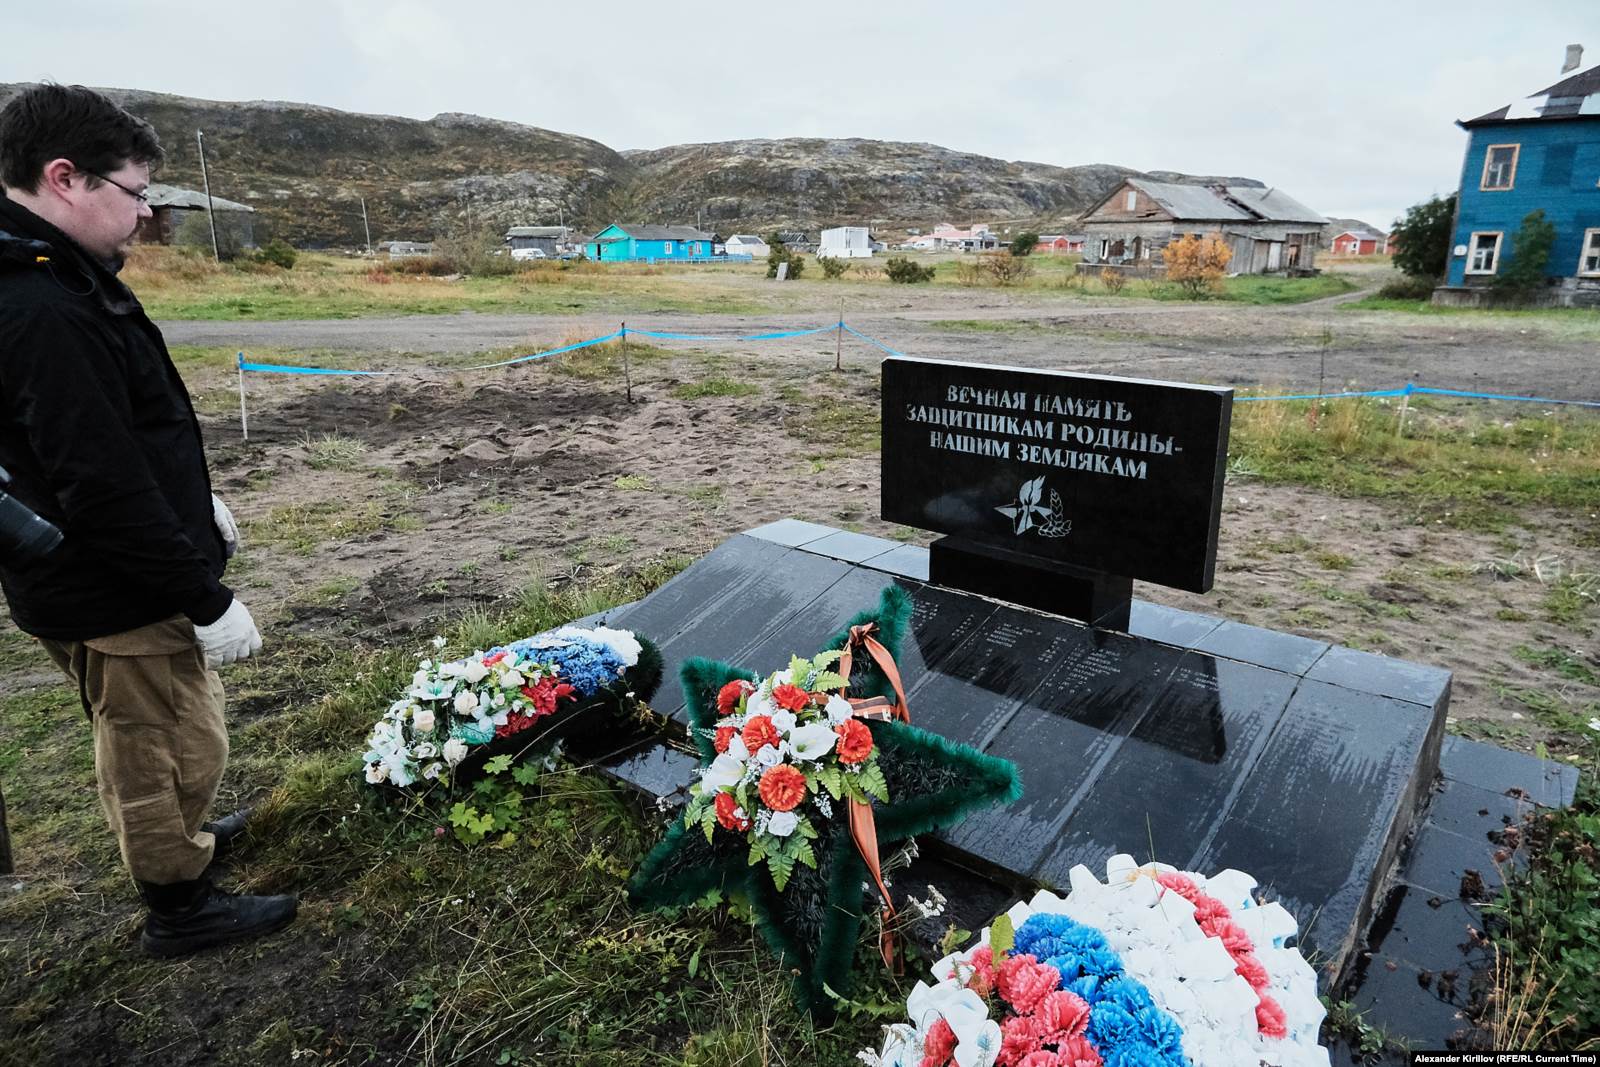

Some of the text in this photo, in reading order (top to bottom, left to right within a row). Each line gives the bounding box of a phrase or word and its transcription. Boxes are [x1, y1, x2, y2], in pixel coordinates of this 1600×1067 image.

[906, 404, 1053, 440] ЗАЩИТНИКАМ
[946, 385, 1132, 422] ВЕЧНАЯ ПАМЯТЬ
[930, 431, 1147, 479] НАШИМ ЗЕМЛЯКАМ
